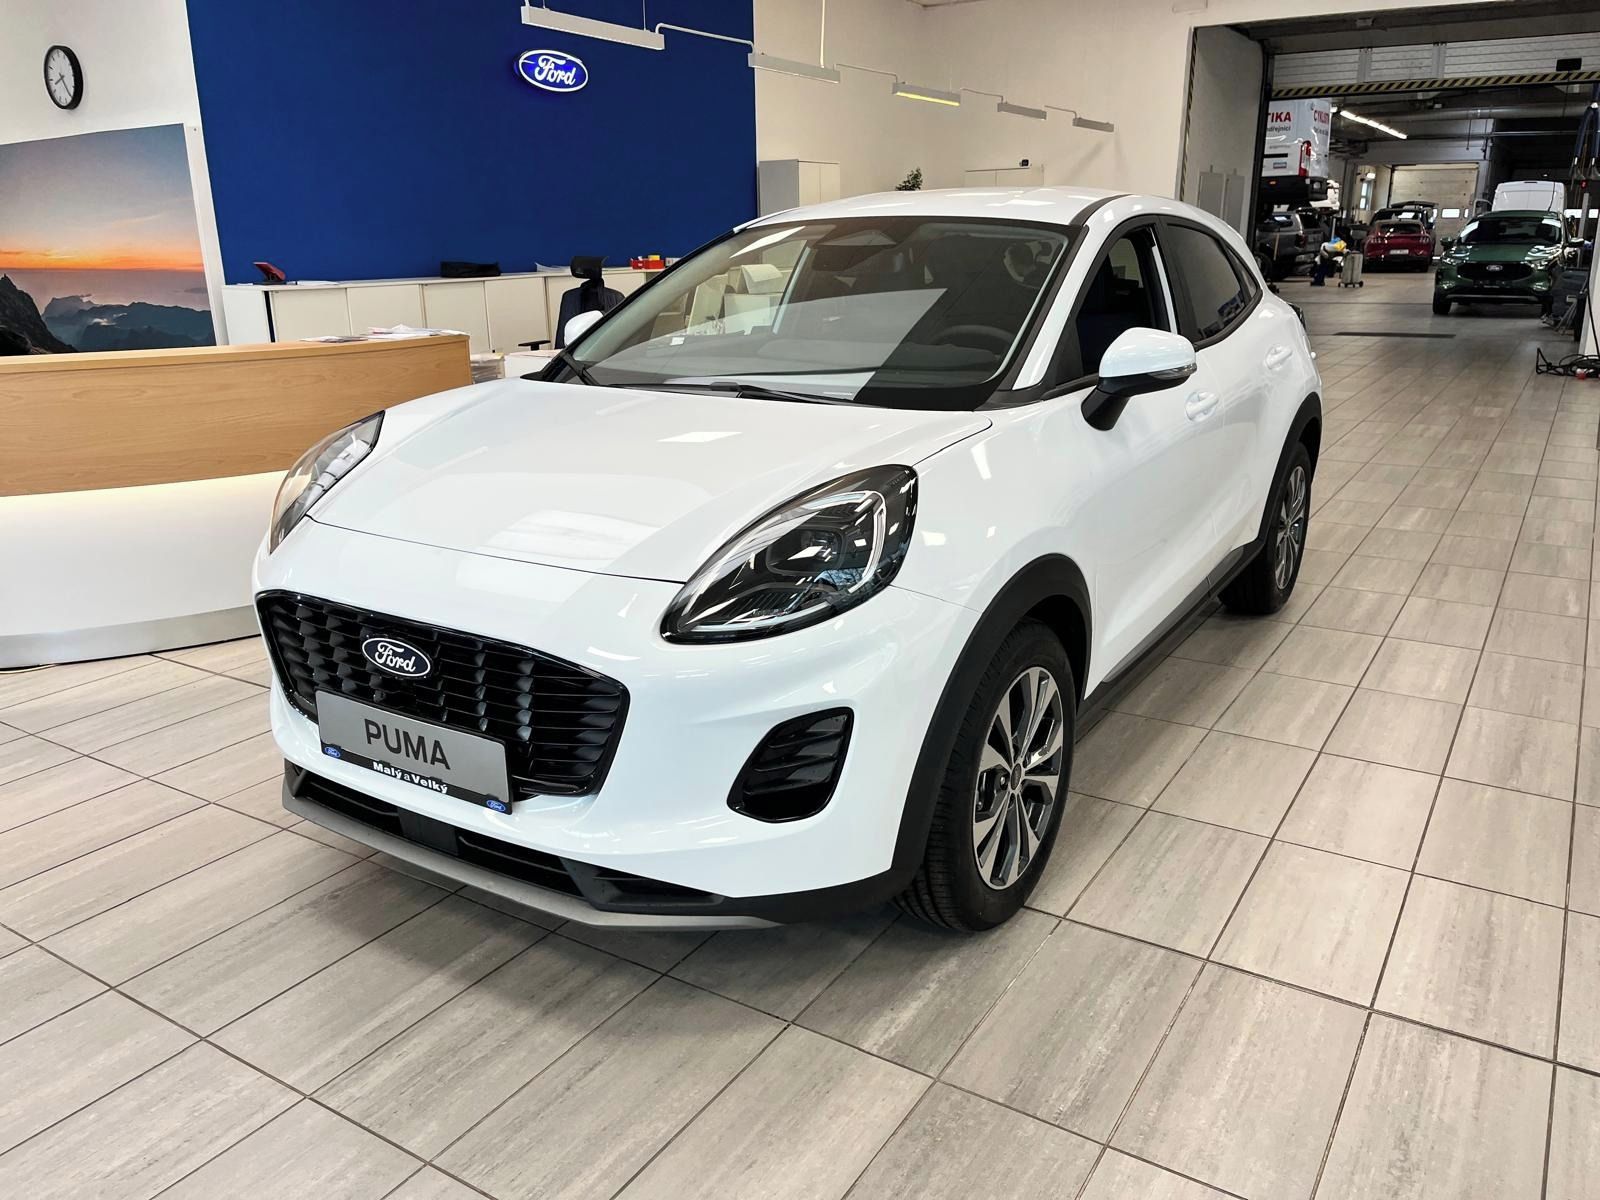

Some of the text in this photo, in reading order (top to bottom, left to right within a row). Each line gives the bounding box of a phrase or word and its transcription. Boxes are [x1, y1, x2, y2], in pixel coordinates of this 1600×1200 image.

[534, 55, 577, 85] Ford
[1268, 111, 1292, 122] IKA
[375, 642, 416, 673] Ford
[364, 718, 451, 770] PUMA
[373, 761, 448, 794] Malý a Velký
